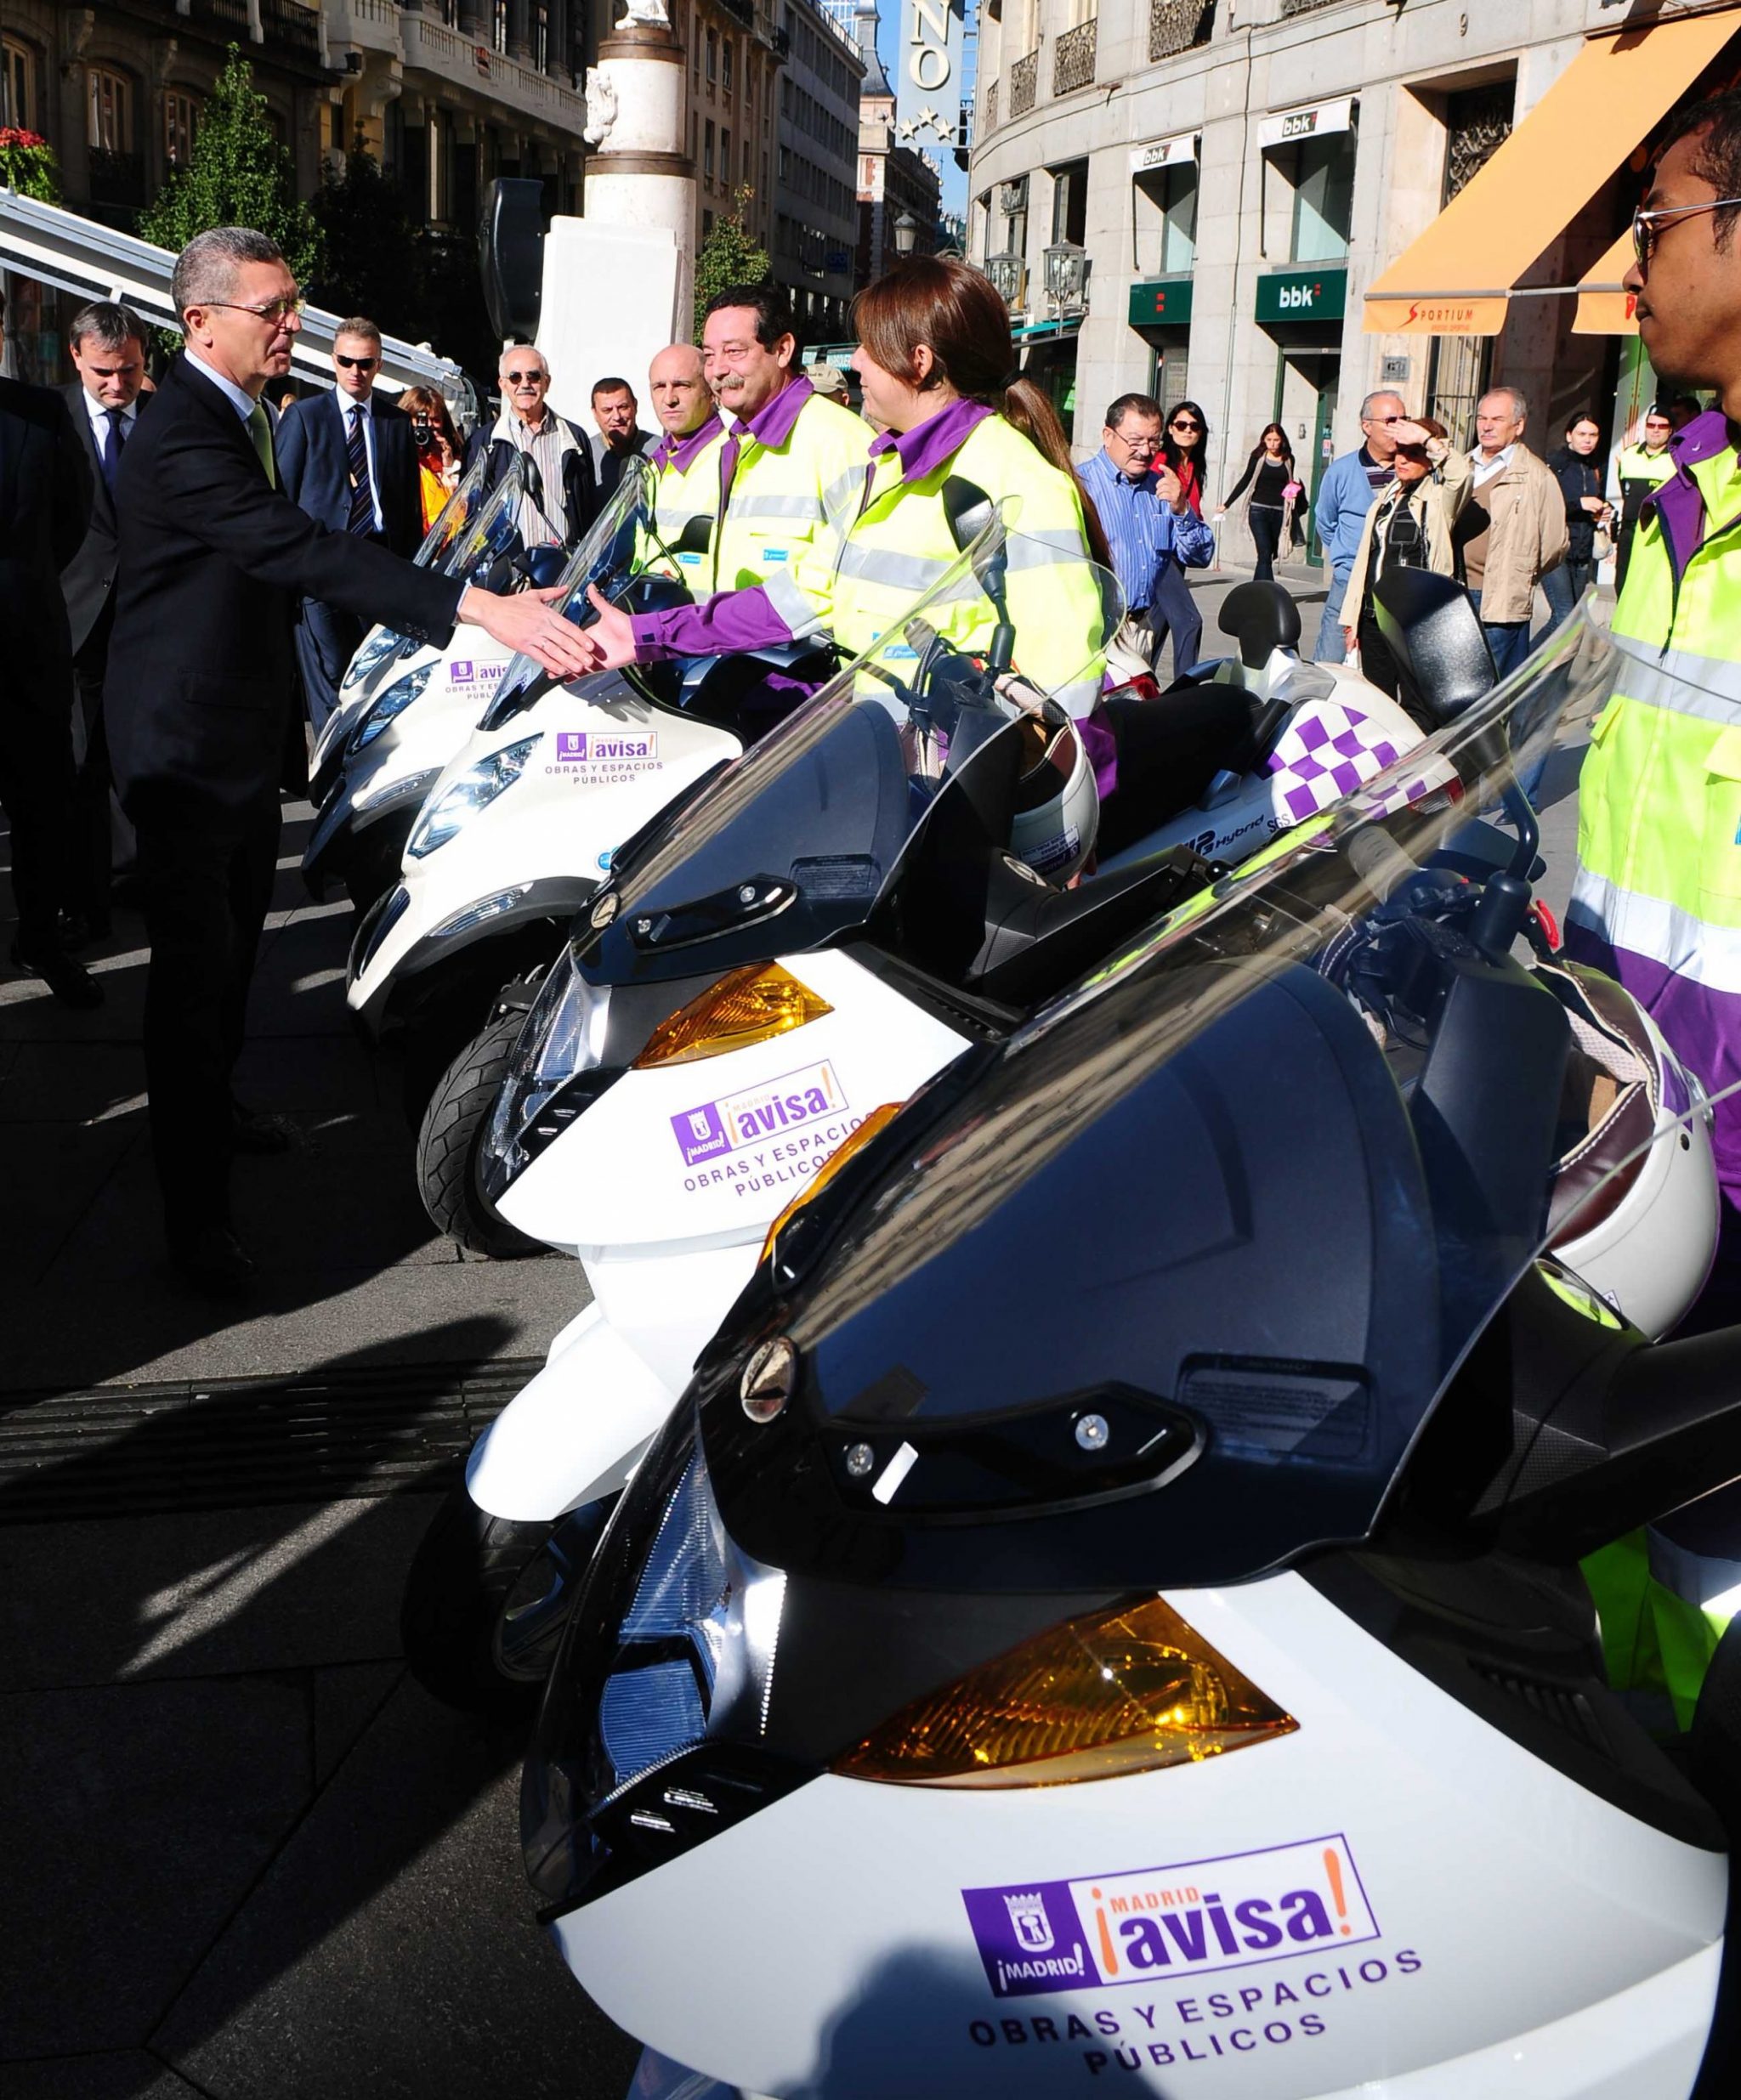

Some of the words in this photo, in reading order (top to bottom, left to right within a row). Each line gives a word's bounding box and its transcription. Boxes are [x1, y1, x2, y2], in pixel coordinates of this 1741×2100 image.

[1283, 115, 1311, 135] bbk
[1144, 148, 1166, 164] bbk
[1279, 285, 1313, 307] bbk
[545, 765, 587, 774] OBRAS
[602, 761, 663, 773] ESPACIOS
[683, 1160, 750, 1192] OBRAS
[754, 1153, 766, 1168] Y
[1110, 1886, 1200, 1915] MADRID
[997, 1942, 1085, 1992] ¡MADRID!
[968, 2011, 1120, 2047] OBRAS
[1133, 2005, 1156, 2029] Y
[1176, 1950, 1423, 2024] ESPACIOS
[1083, 2012, 1326, 2075] PÚBLICOS
